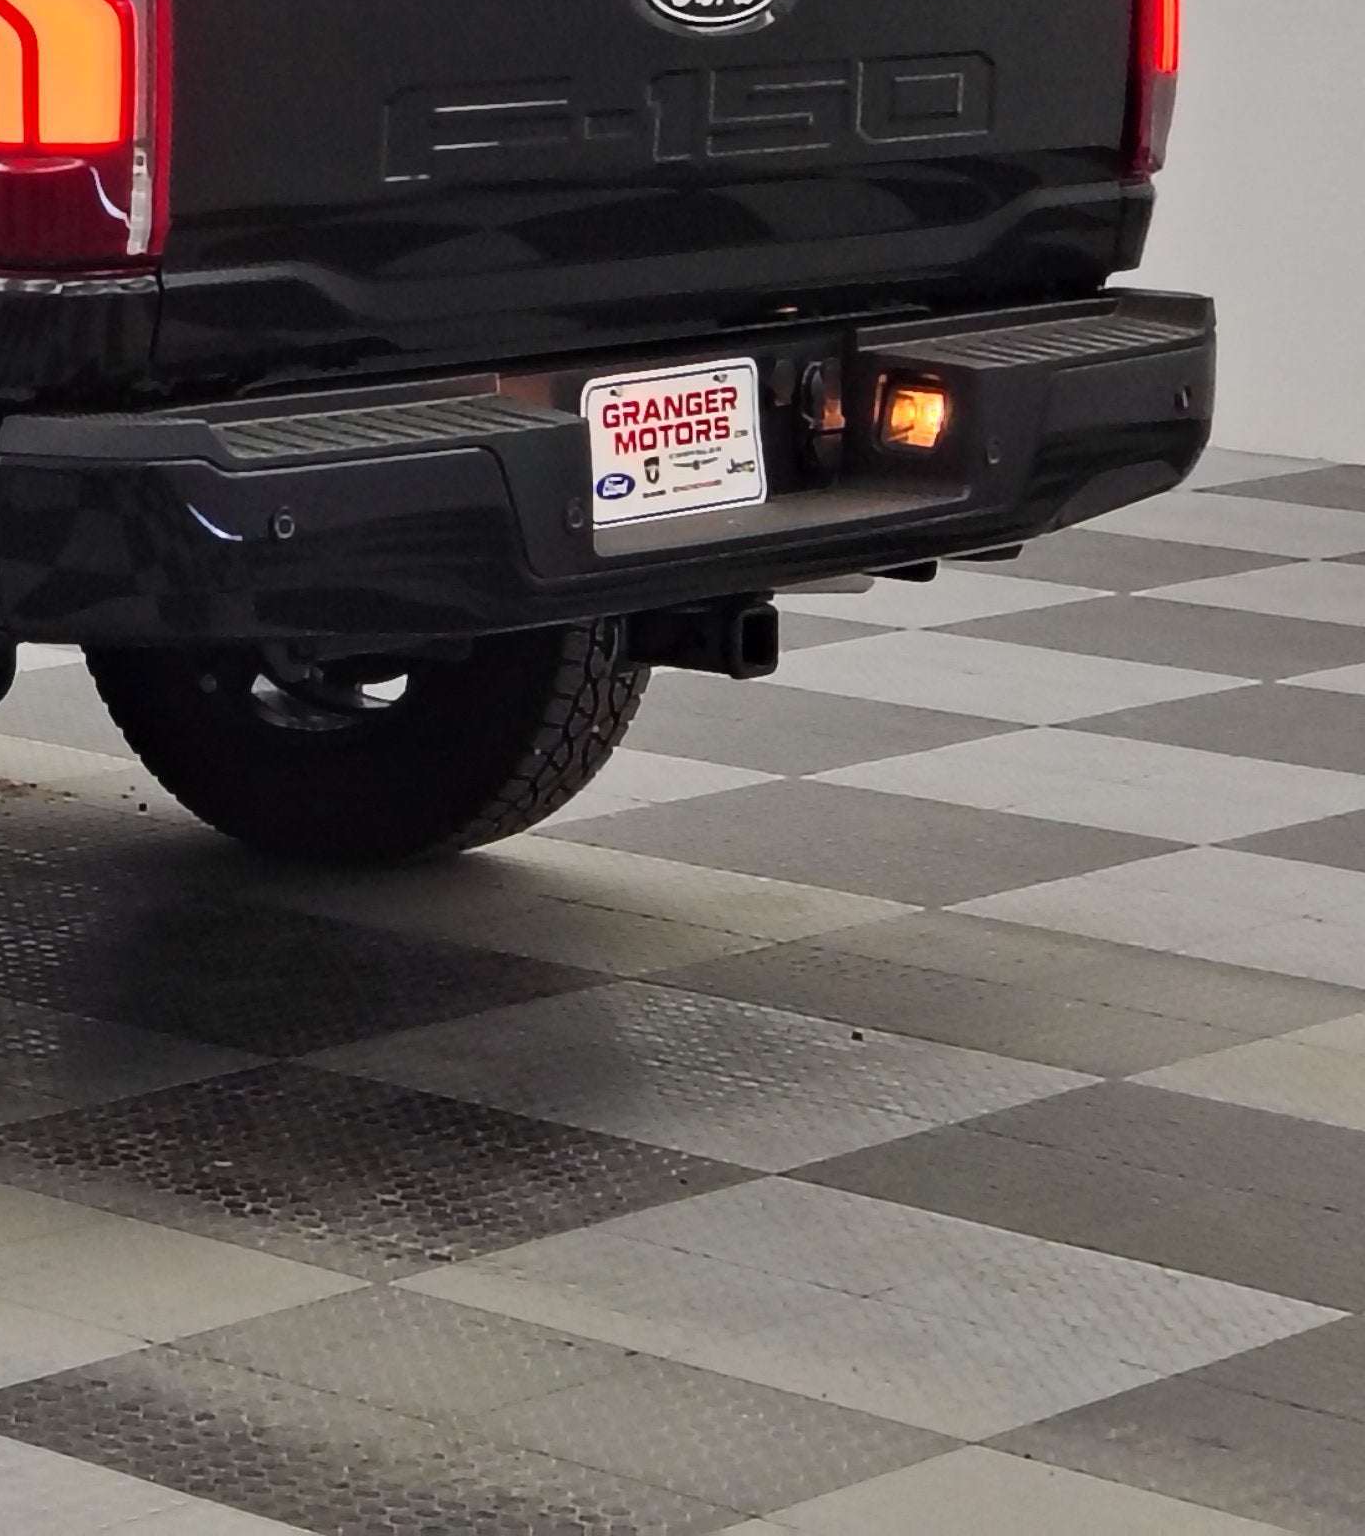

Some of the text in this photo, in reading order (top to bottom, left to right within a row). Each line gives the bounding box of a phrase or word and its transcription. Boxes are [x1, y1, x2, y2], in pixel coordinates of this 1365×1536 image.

[380, 50, 995, 183] F-150
[602, 386, 738, 429] GRANGER
[614, 416, 731, 456] MOTORS
